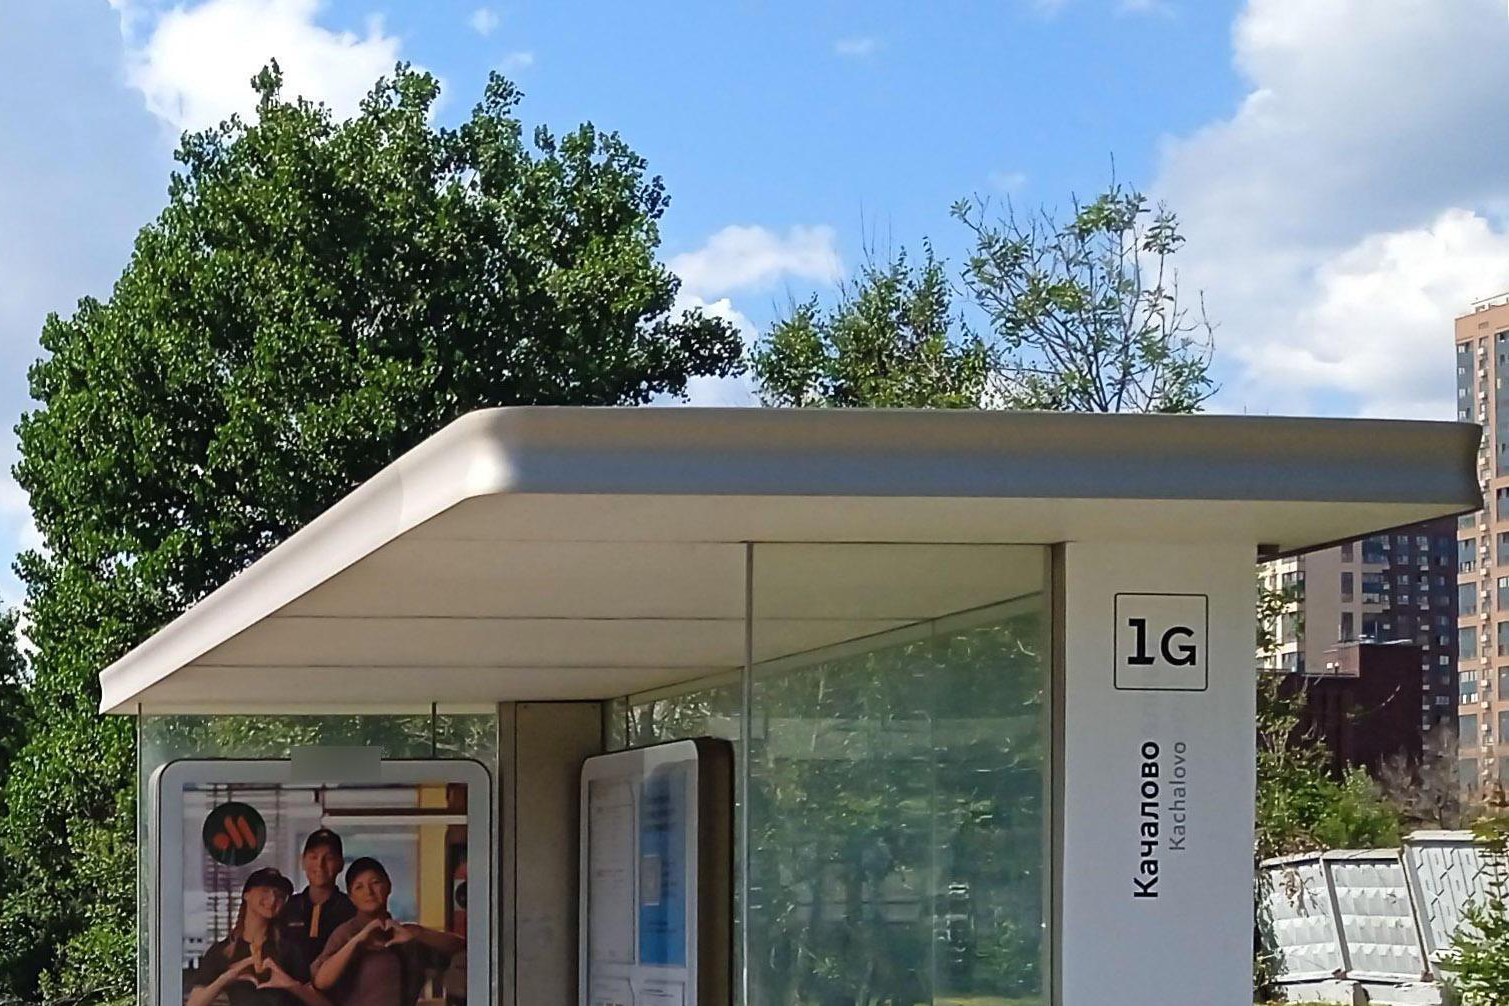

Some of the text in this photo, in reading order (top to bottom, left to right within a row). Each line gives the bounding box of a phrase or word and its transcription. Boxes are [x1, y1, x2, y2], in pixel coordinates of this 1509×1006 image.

[1127, 618, 1197, 666] 1G
[1133, 741, 1160, 898] Качалово
[1168, 741, 1187, 851] Kachalovo
